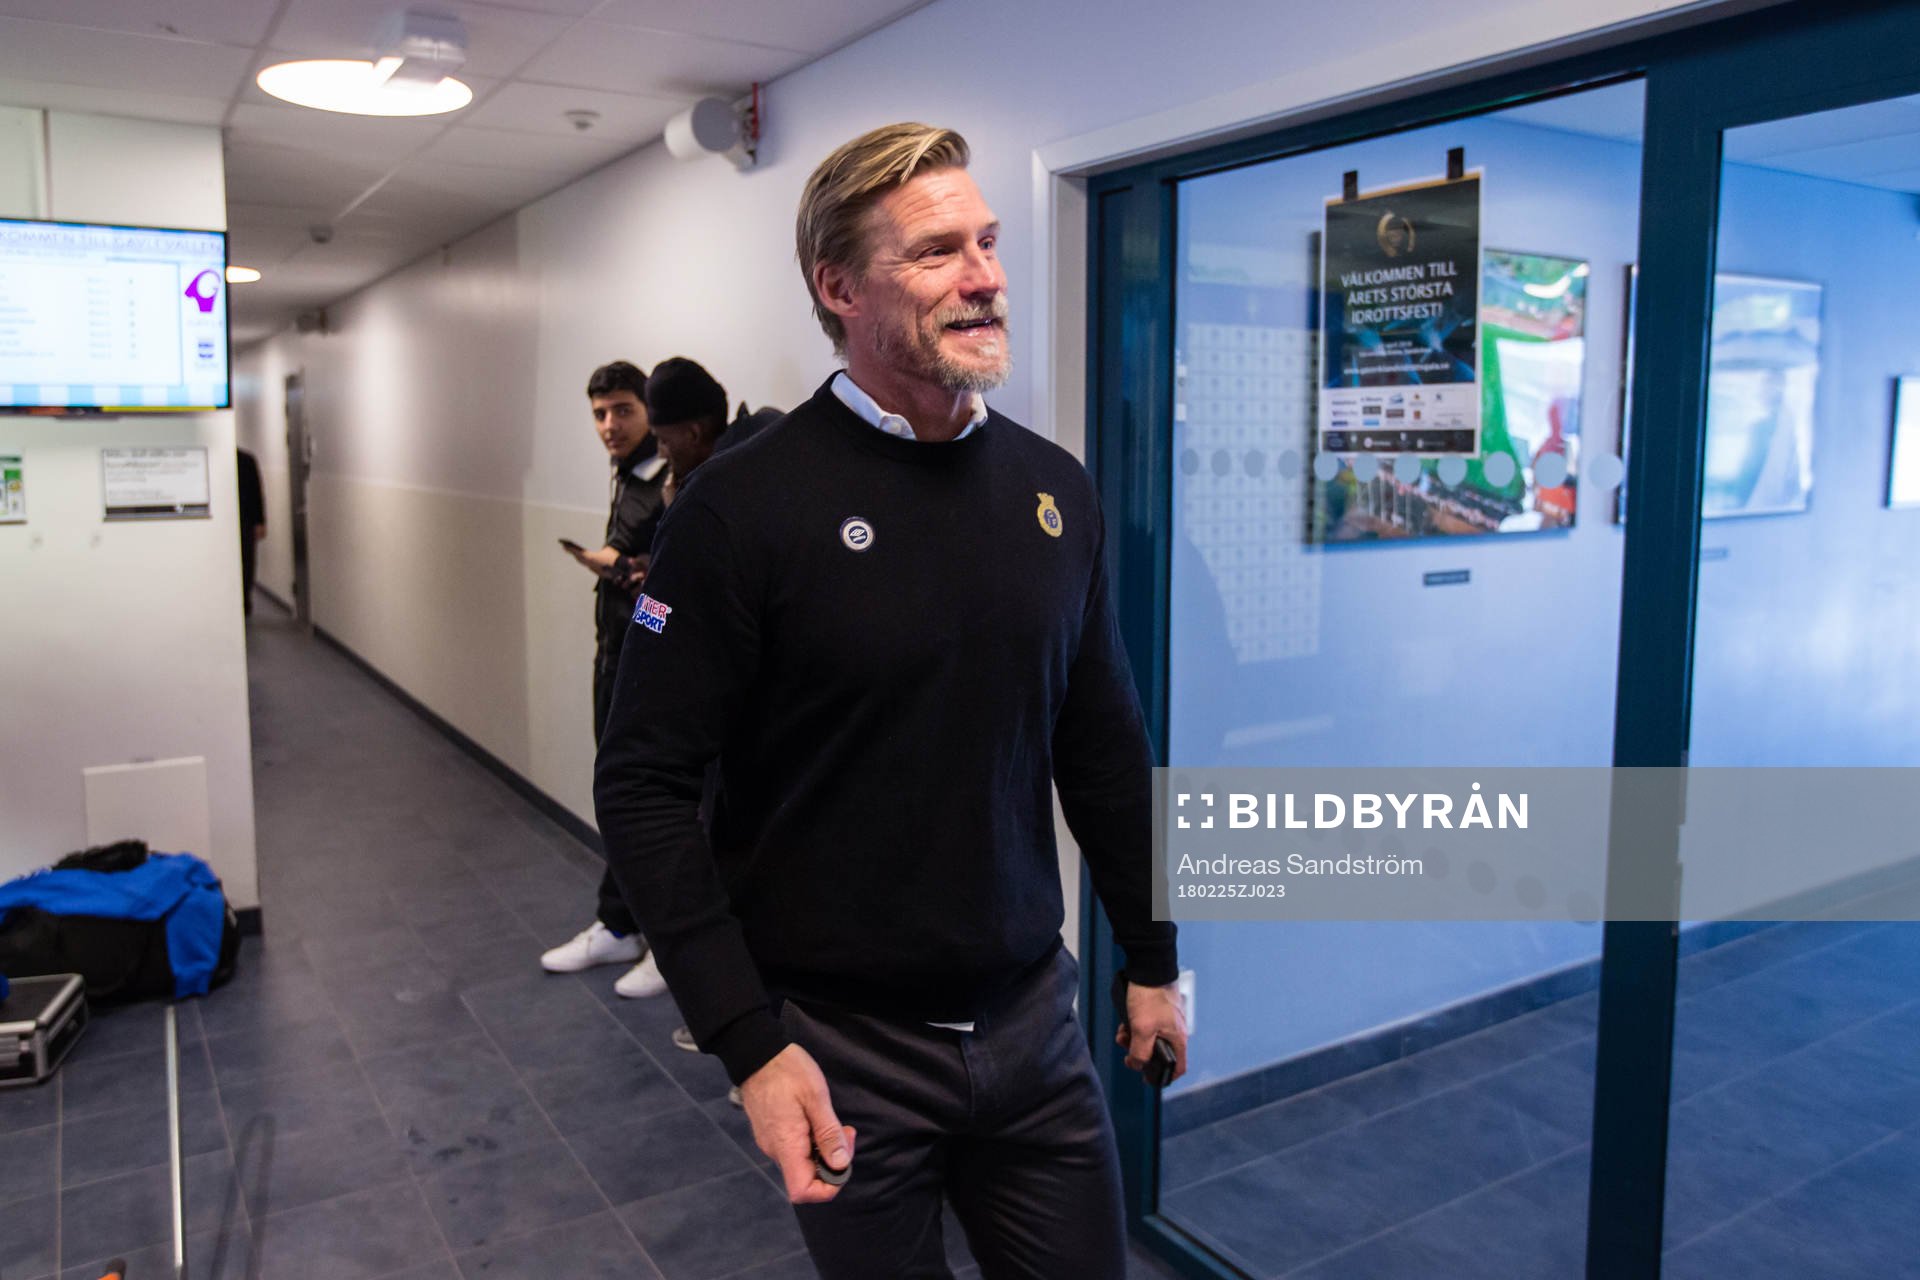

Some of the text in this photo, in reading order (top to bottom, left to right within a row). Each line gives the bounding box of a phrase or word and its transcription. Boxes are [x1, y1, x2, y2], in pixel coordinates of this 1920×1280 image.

[1427, 260, 1458, 277] TILL
[1351, 301, 1444, 325] IDROTTSFEST!
[635, 610, 664, 633] SPORT
